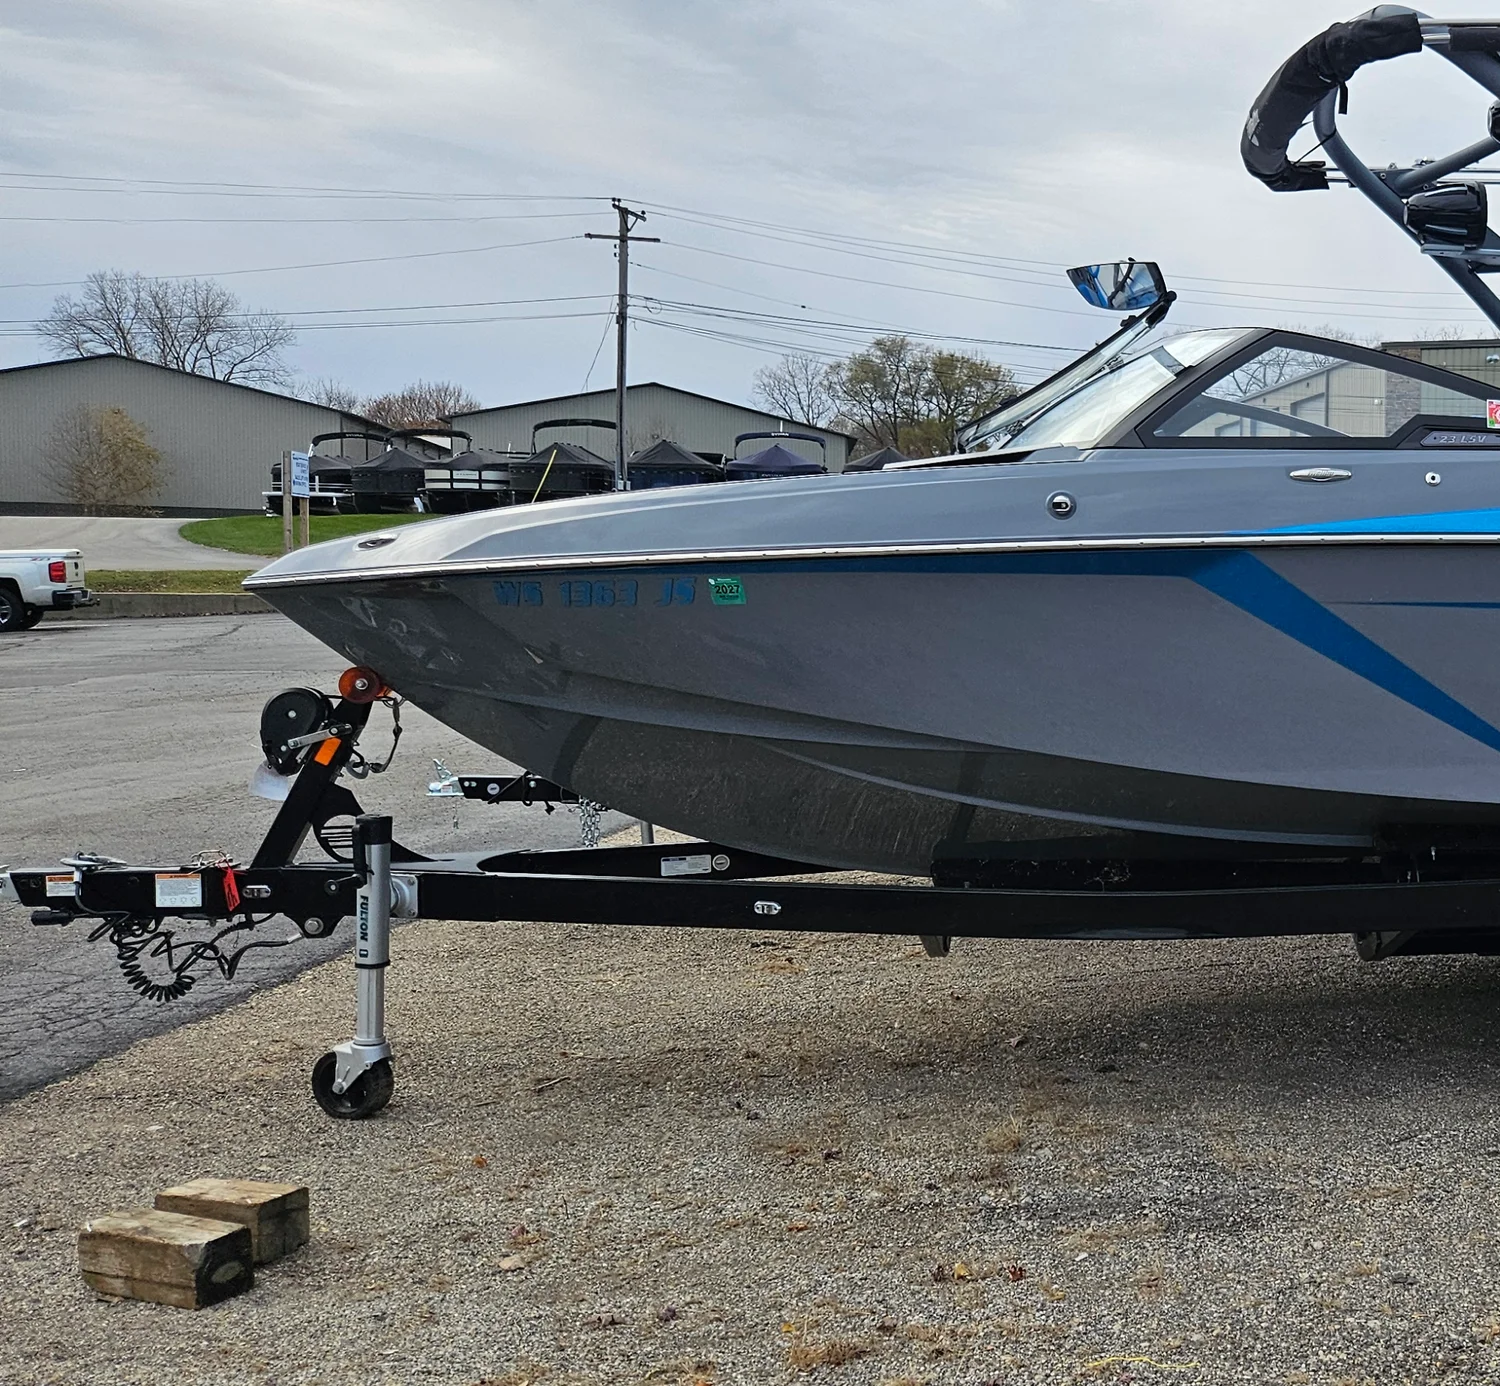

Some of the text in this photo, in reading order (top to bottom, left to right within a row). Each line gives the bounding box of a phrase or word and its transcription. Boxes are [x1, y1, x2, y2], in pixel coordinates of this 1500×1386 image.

[1439, 435, 1487, 444] 23 LSV
[714, 584, 740, 595] 2027
[360, 895, 369, 942] FULTON
